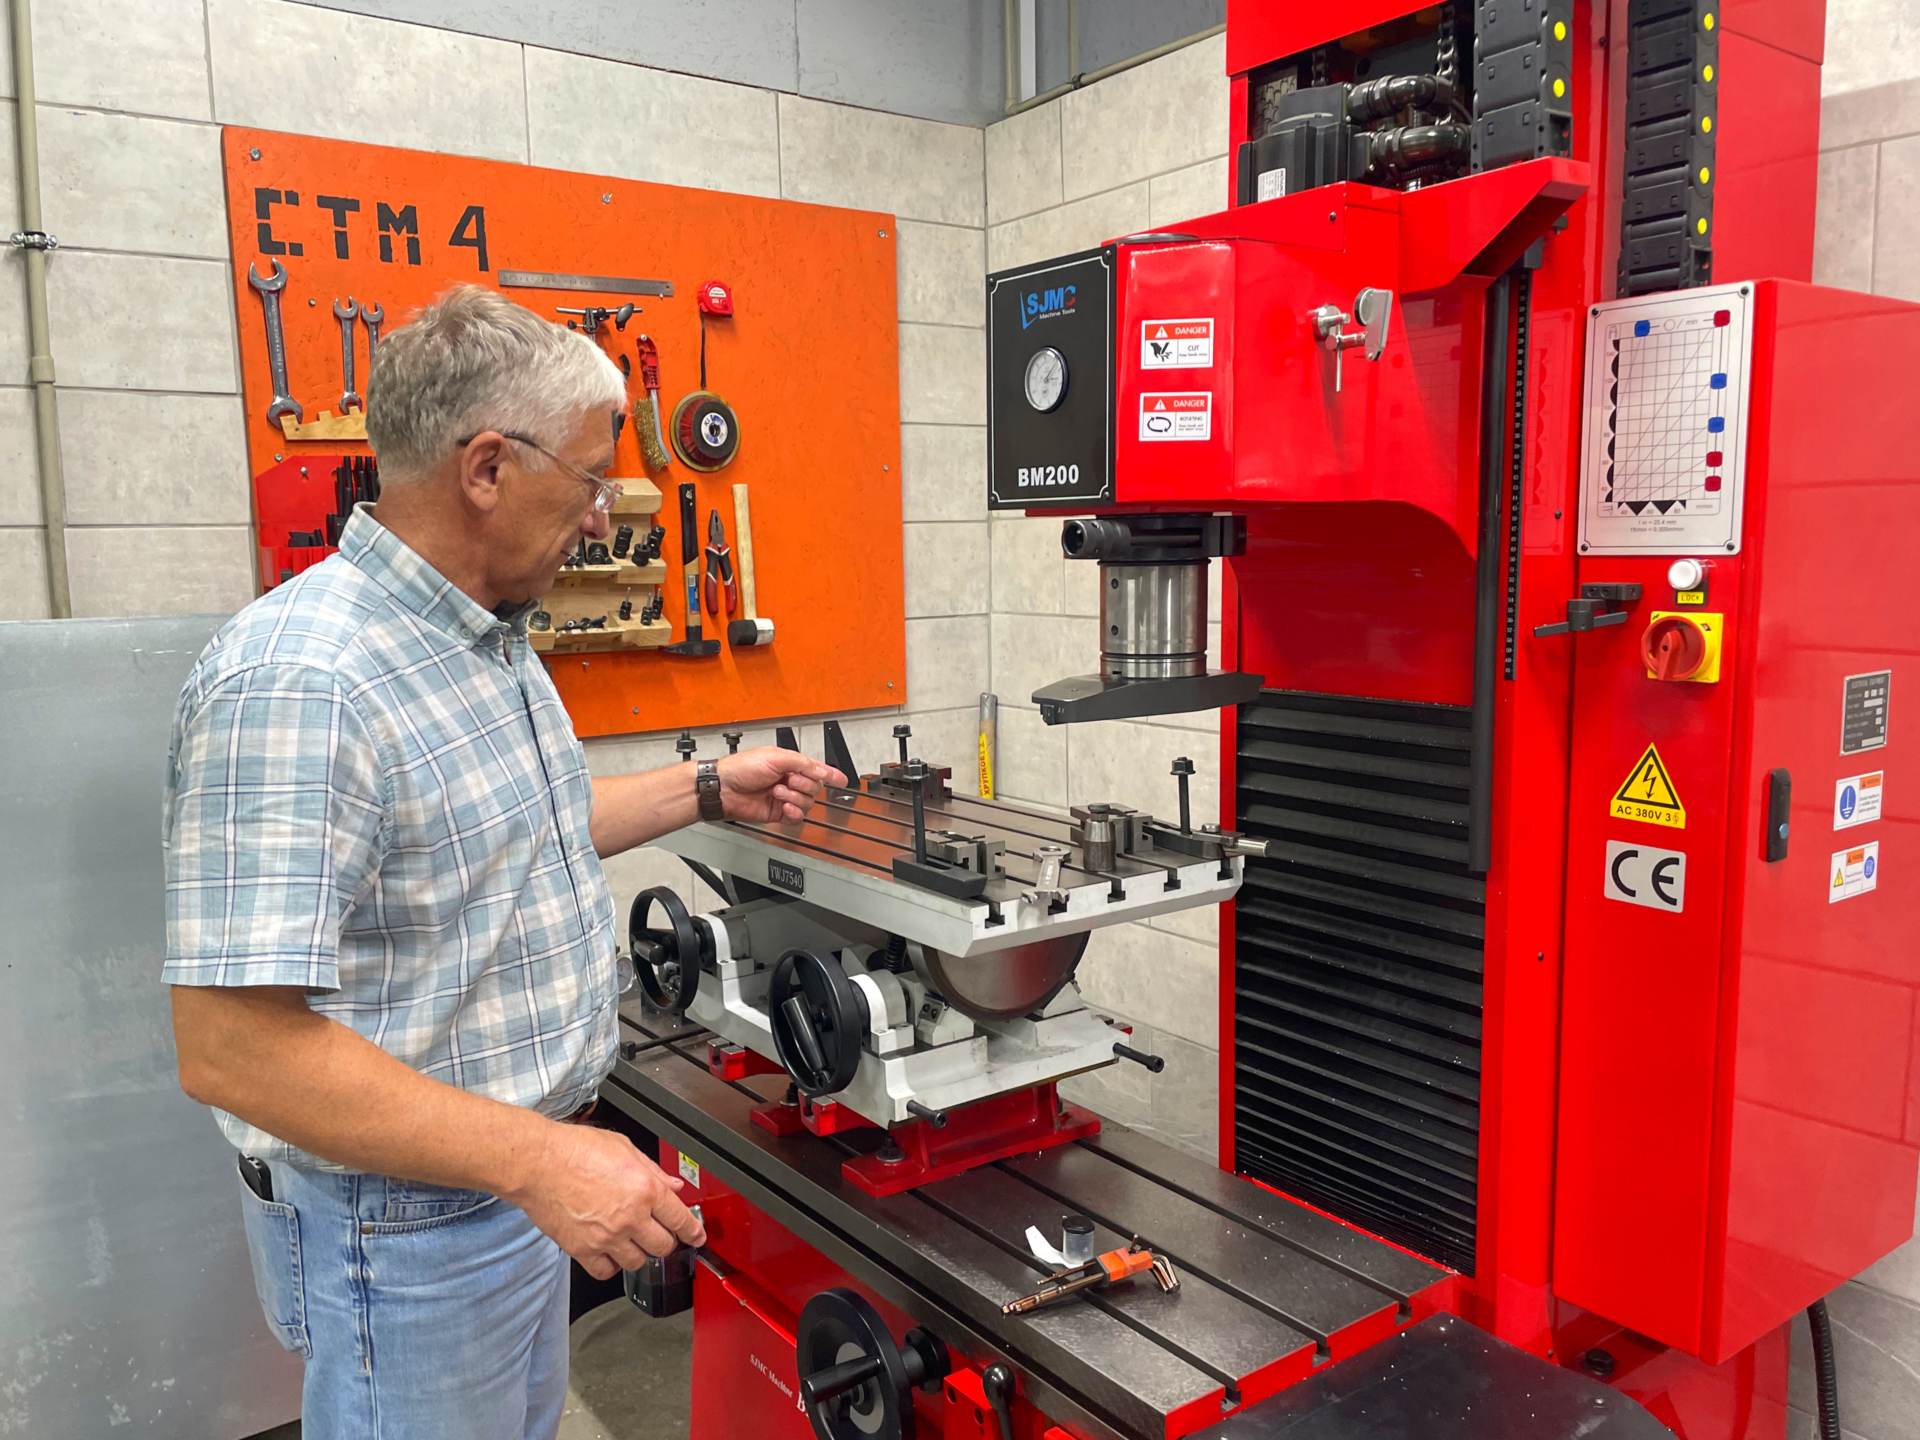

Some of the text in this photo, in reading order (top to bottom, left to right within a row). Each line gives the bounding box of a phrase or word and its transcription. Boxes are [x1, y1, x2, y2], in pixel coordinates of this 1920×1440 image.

[449, 205, 489, 272] 4
[1027, 285, 1076, 315] SJMC
[1039, 308, 1076, 320] Machine Tools
[1175, 326, 1207, 335] DANGER
[1174, 400, 1205, 408] DANGER
[1018, 464, 1079, 486] BM200
[1616, 805, 1632, 815] AC
[1636, 808, 1661, 820] 380V
[770, 864, 802, 888] YWJ7540
[1612, 850, 1680, 906] CE
[750, 1354, 793, 1398] SJMC Machine
